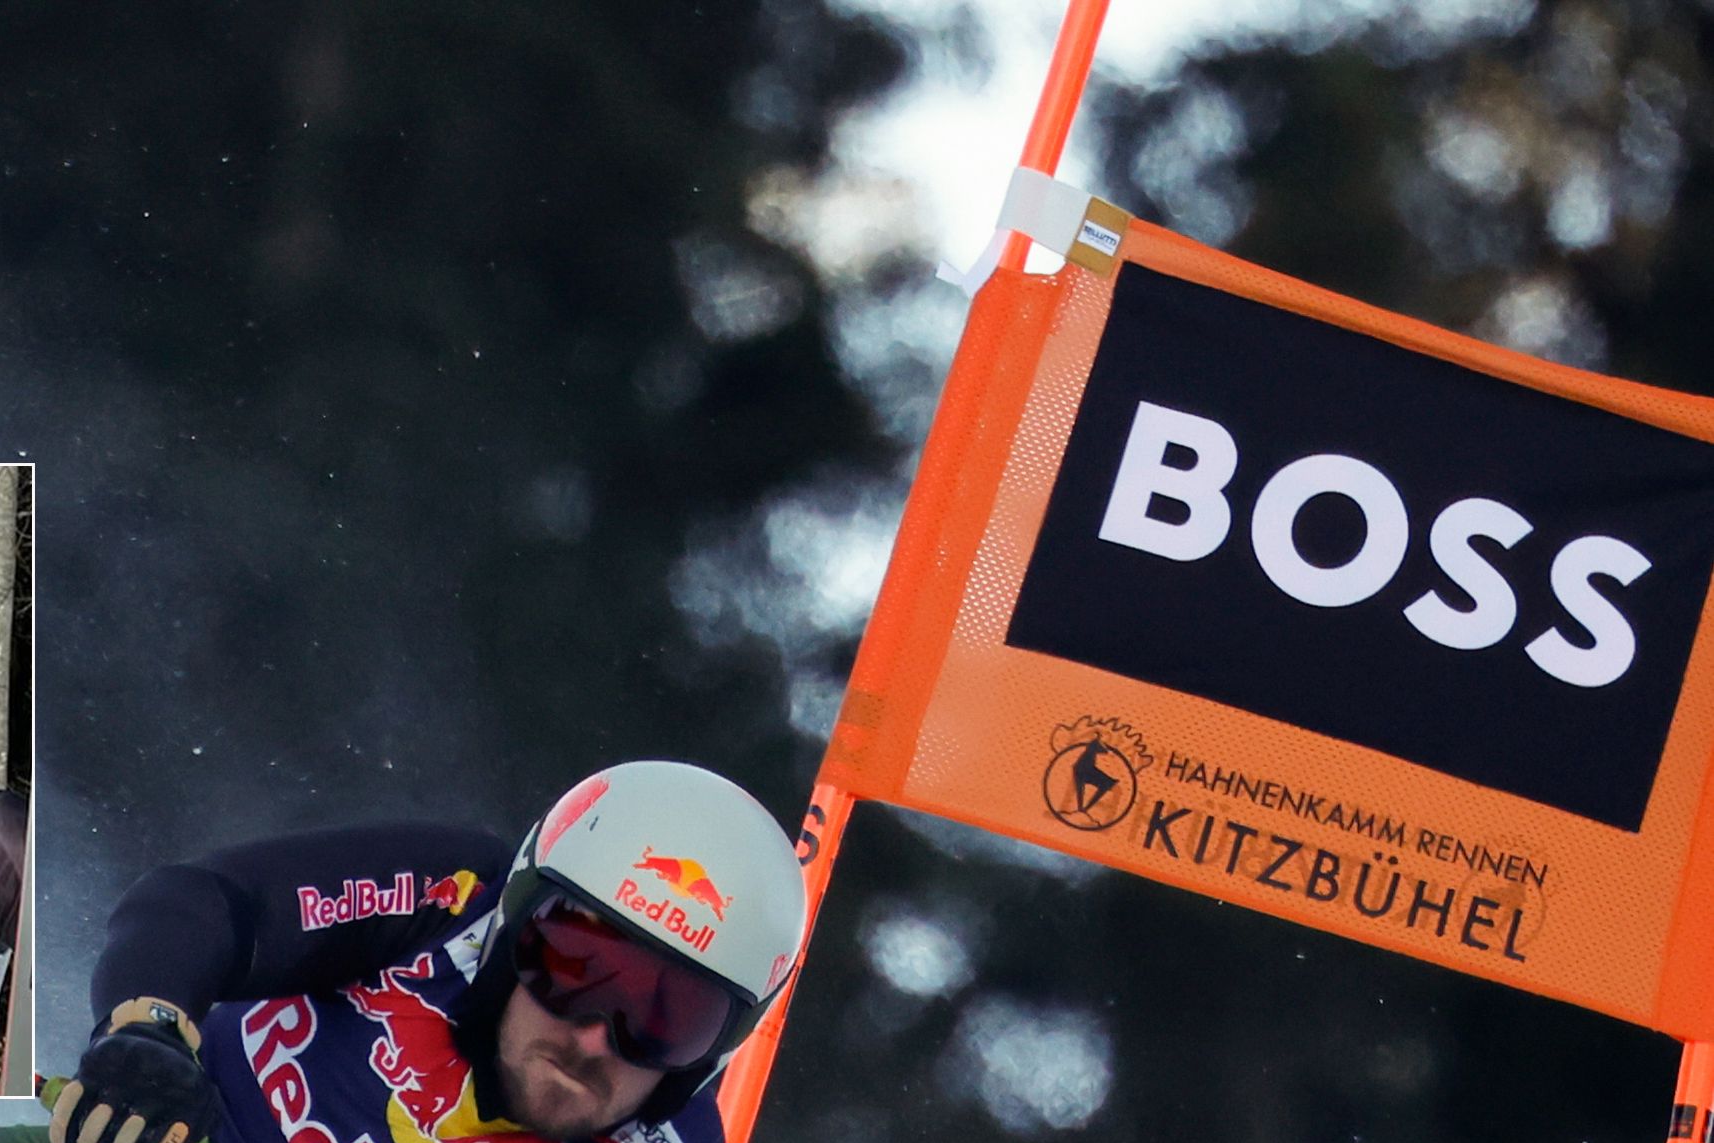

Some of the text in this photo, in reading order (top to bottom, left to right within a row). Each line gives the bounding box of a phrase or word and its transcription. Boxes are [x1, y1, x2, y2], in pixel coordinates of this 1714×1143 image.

[1098, 400, 1653, 688] BOSS
[1143, 801, 1527, 963] KITZBÜHEL
[1164, 751, 1548, 889] HAHNENKAMM RENNEN
[297, 872, 415, 931] Red Bull
[614, 878, 716, 953] Red Bull
